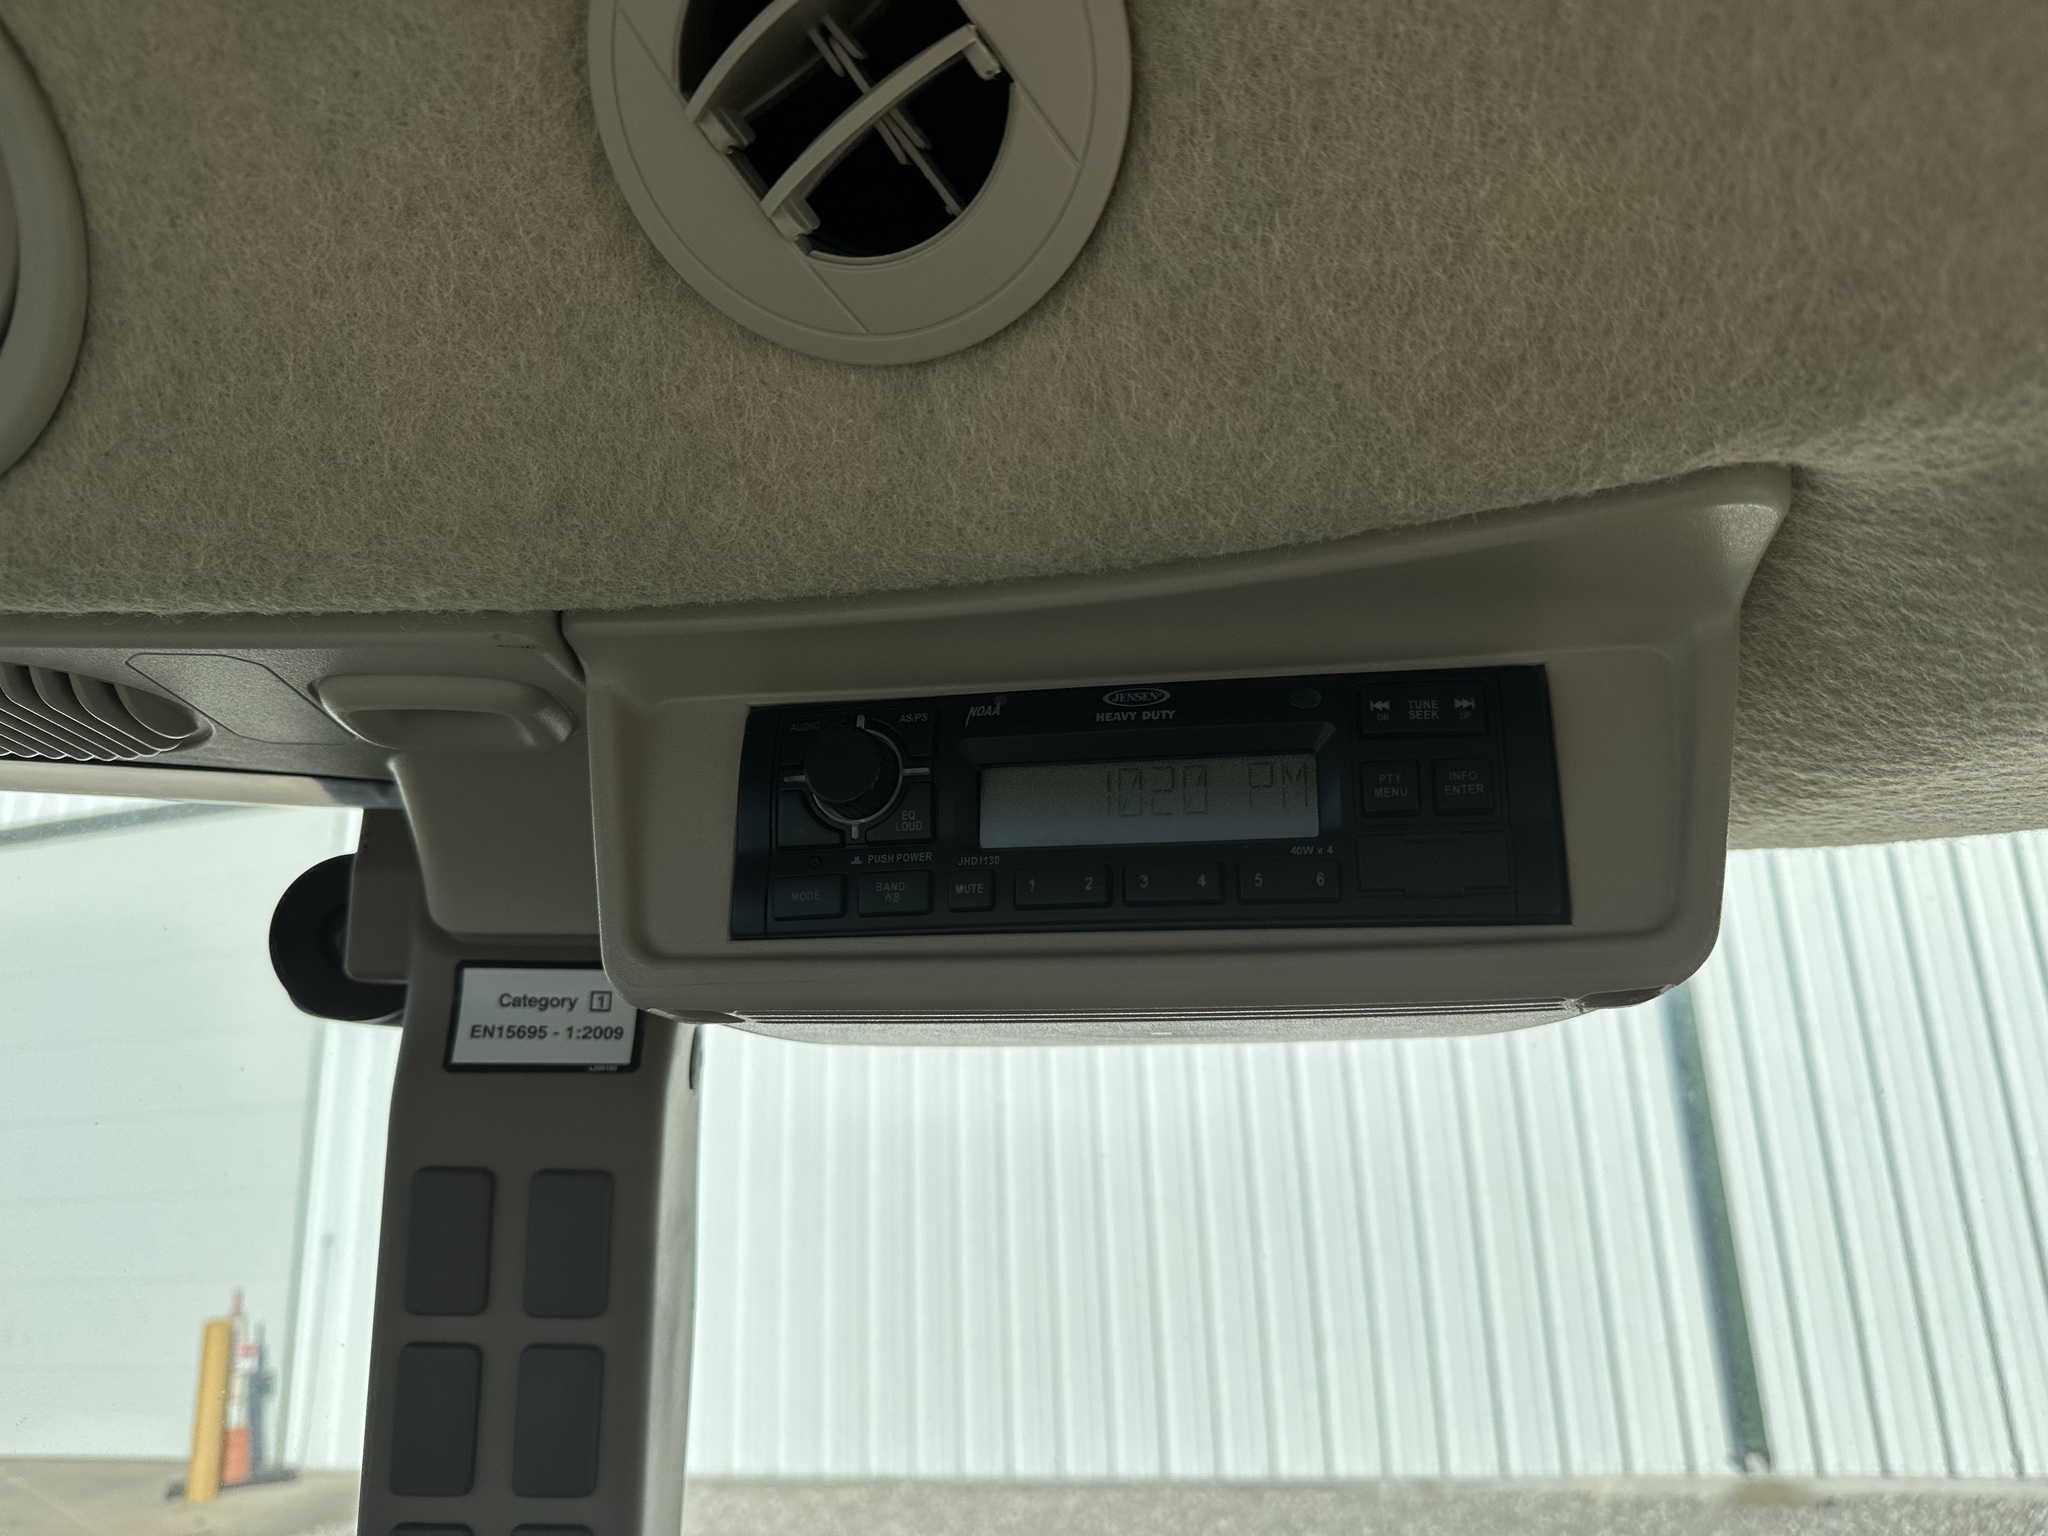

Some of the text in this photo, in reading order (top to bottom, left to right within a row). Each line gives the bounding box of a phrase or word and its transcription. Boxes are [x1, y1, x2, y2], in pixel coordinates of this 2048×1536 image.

[1112, 691, 1158, 703] JENSEN
[1408, 699, 1439, 710] TUNE
[898, 712, 928, 724] AS/PS
[965, 703, 1001, 729] NOAA
[1095, 709, 1176, 722] HEAVY DUTY
[1376, 713, 1390, 722] DN
[1408, 709, 1440, 720] SEEK
[1459, 711, 1472, 720] UP
[789, 721, 821, 733] AUDIO
[1378, 773, 1402, 784] PTY
[1449, 770, 1478, 782] INFO
[1248, 761, 1308, 811] PM
[1374, 786, 1408, 798] MENU
[1444, 783, 1485, 795] ENTER
[901, 810, 916, 821] EQ
[895, 821, 923, 832] LOUD
[1289, 846, 1314, 856] 40W
[1326, 845, 1334, 855] 4
[867, 852, 933, 864] PUSH POWER
[957, 855, 1000, 866] JHD1130
[1083, 877, 1093, 891] 2
[1139, 875, 1149, 889] 3
[1197, 874, 1207, 888] 4
[1254, 873, 1263, 887] 5
[1316, 872, 1325, 886] 6
[954, 883, 984, 894] MUTE
[1027, 879, 1036, 893] 1
[791, 890, 821, 902] MODE
[499, 992, 579, 1012] Category
[470, 1024, 548, 1040] EN15695
[566, 1025, 625, 1041] 1:2009
